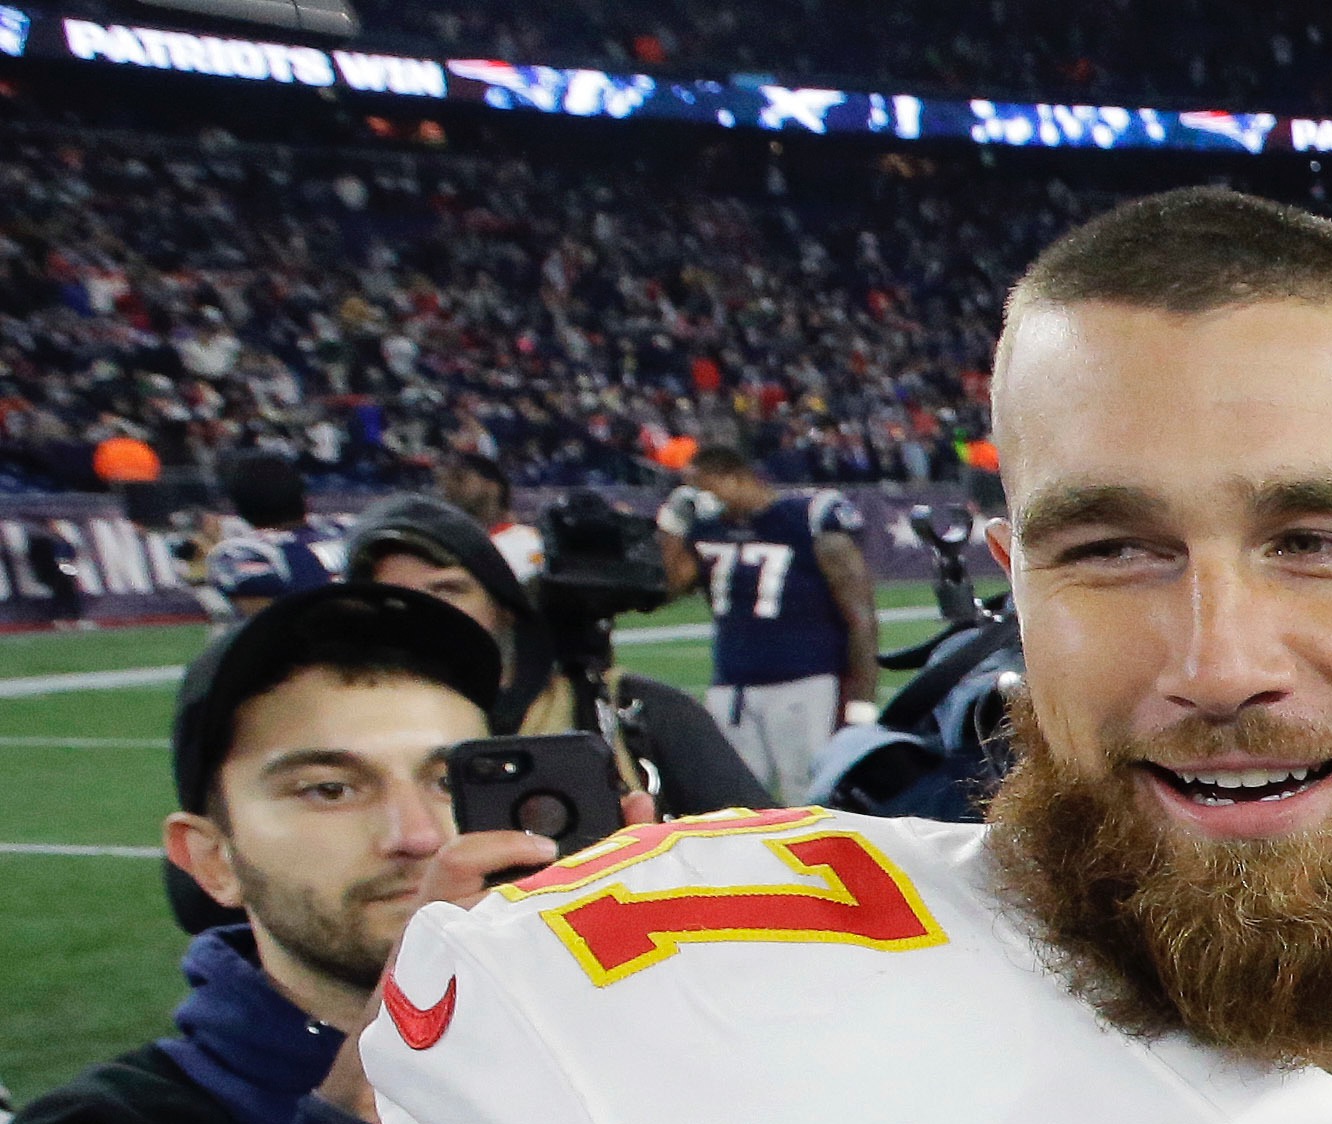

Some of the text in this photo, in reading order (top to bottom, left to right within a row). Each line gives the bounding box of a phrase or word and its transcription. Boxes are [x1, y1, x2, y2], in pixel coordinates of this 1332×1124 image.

[63, 17, 447, 98] PATRIOTS WIN
[694, 541, 795, 619] 77
